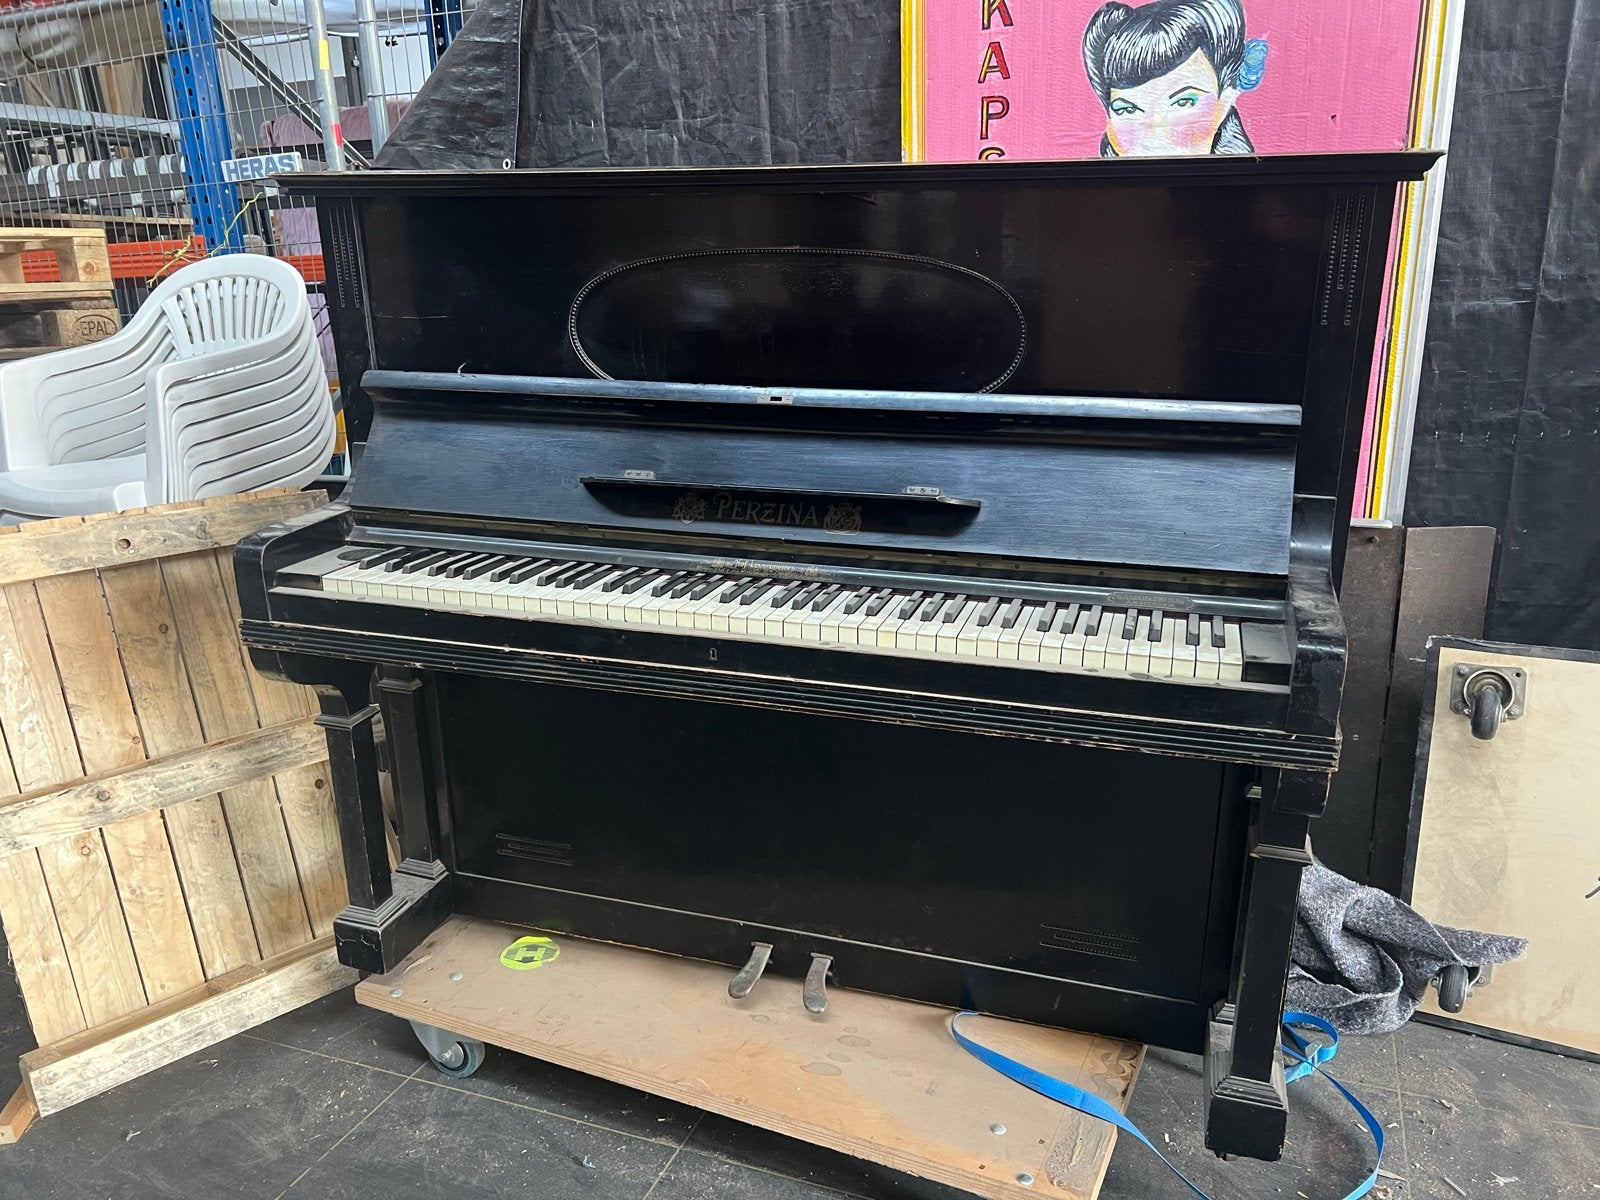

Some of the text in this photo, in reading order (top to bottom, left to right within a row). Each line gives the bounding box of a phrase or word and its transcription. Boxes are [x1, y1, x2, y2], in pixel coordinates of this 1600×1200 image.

[225, 155, 295, 181] HERAS
[80, 321, 112, 336] EPAL
[713, 493, 818, 525] PERZINA
